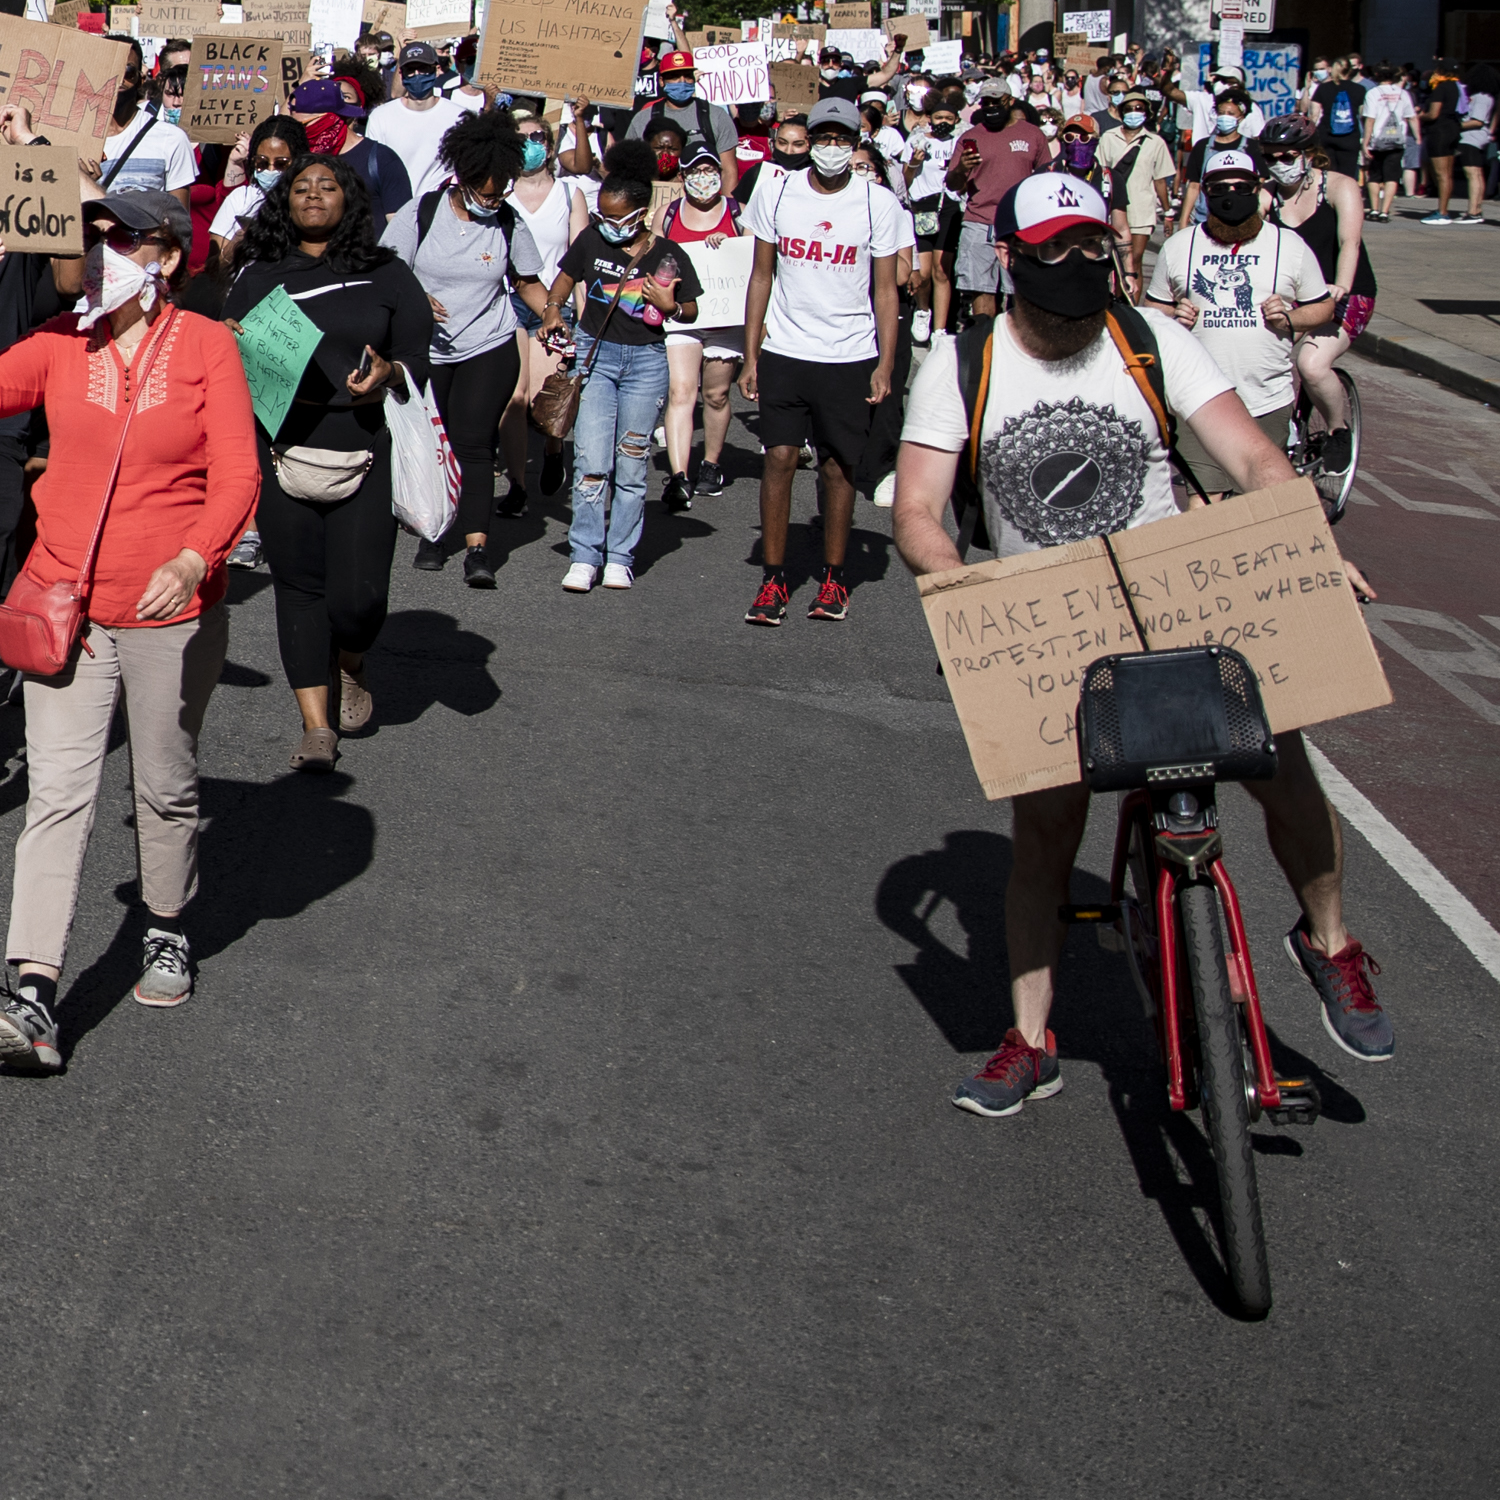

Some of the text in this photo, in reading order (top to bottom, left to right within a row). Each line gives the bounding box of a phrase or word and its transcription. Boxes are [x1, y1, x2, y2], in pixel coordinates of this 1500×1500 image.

[150, 7, 197, 21] UNTIL
[273, 11, 307, 20] JUSTICE
[409, 4, 469, 20] LIKE WATERS
[500, 19, 526, 35] US
[537, 19, 632, 58] HASHTAGS!
[206, 42, 269, 61] BLACK
[695, 45, 738, 60] GOOD
[1243, 50, 1300, 72] BLACK
[728, 55, 763, 69] COPS
[200, 64, 268, 93] TRANS
[521, 77, 541, 88] YOUR
[604, 89, 630, 99] NECK
[697, 70, 743, 102] STAND
[746, 68, 766, 98] UP
[200, 99, 256, 112] LIVES
[191, 112, 258, 127] MATTER
[14, 162, 34, 183] is
[40, 169, 59, 184] a
[1055, 190, 1077, 206] W
[14, 196, 75, 237] Color
[778, 236, 858, 265] USA-JA
[1202, 254, 1260, 265] PROTECT
[1203, 310, 1257, 319] PUBLIC
[1203, 319, 1257, 328] EDUCATION
[264, 320, 300, 356] MATTER
[256, 339, 288, 370] Black
[944, 534, 1327, 650] MAKE EVERY BREATH A
[1076, 627, 1108, 652] IN
[1135, 595, 1233, 637] WORLD
[1254, 570, 1345, 603] WHERE
